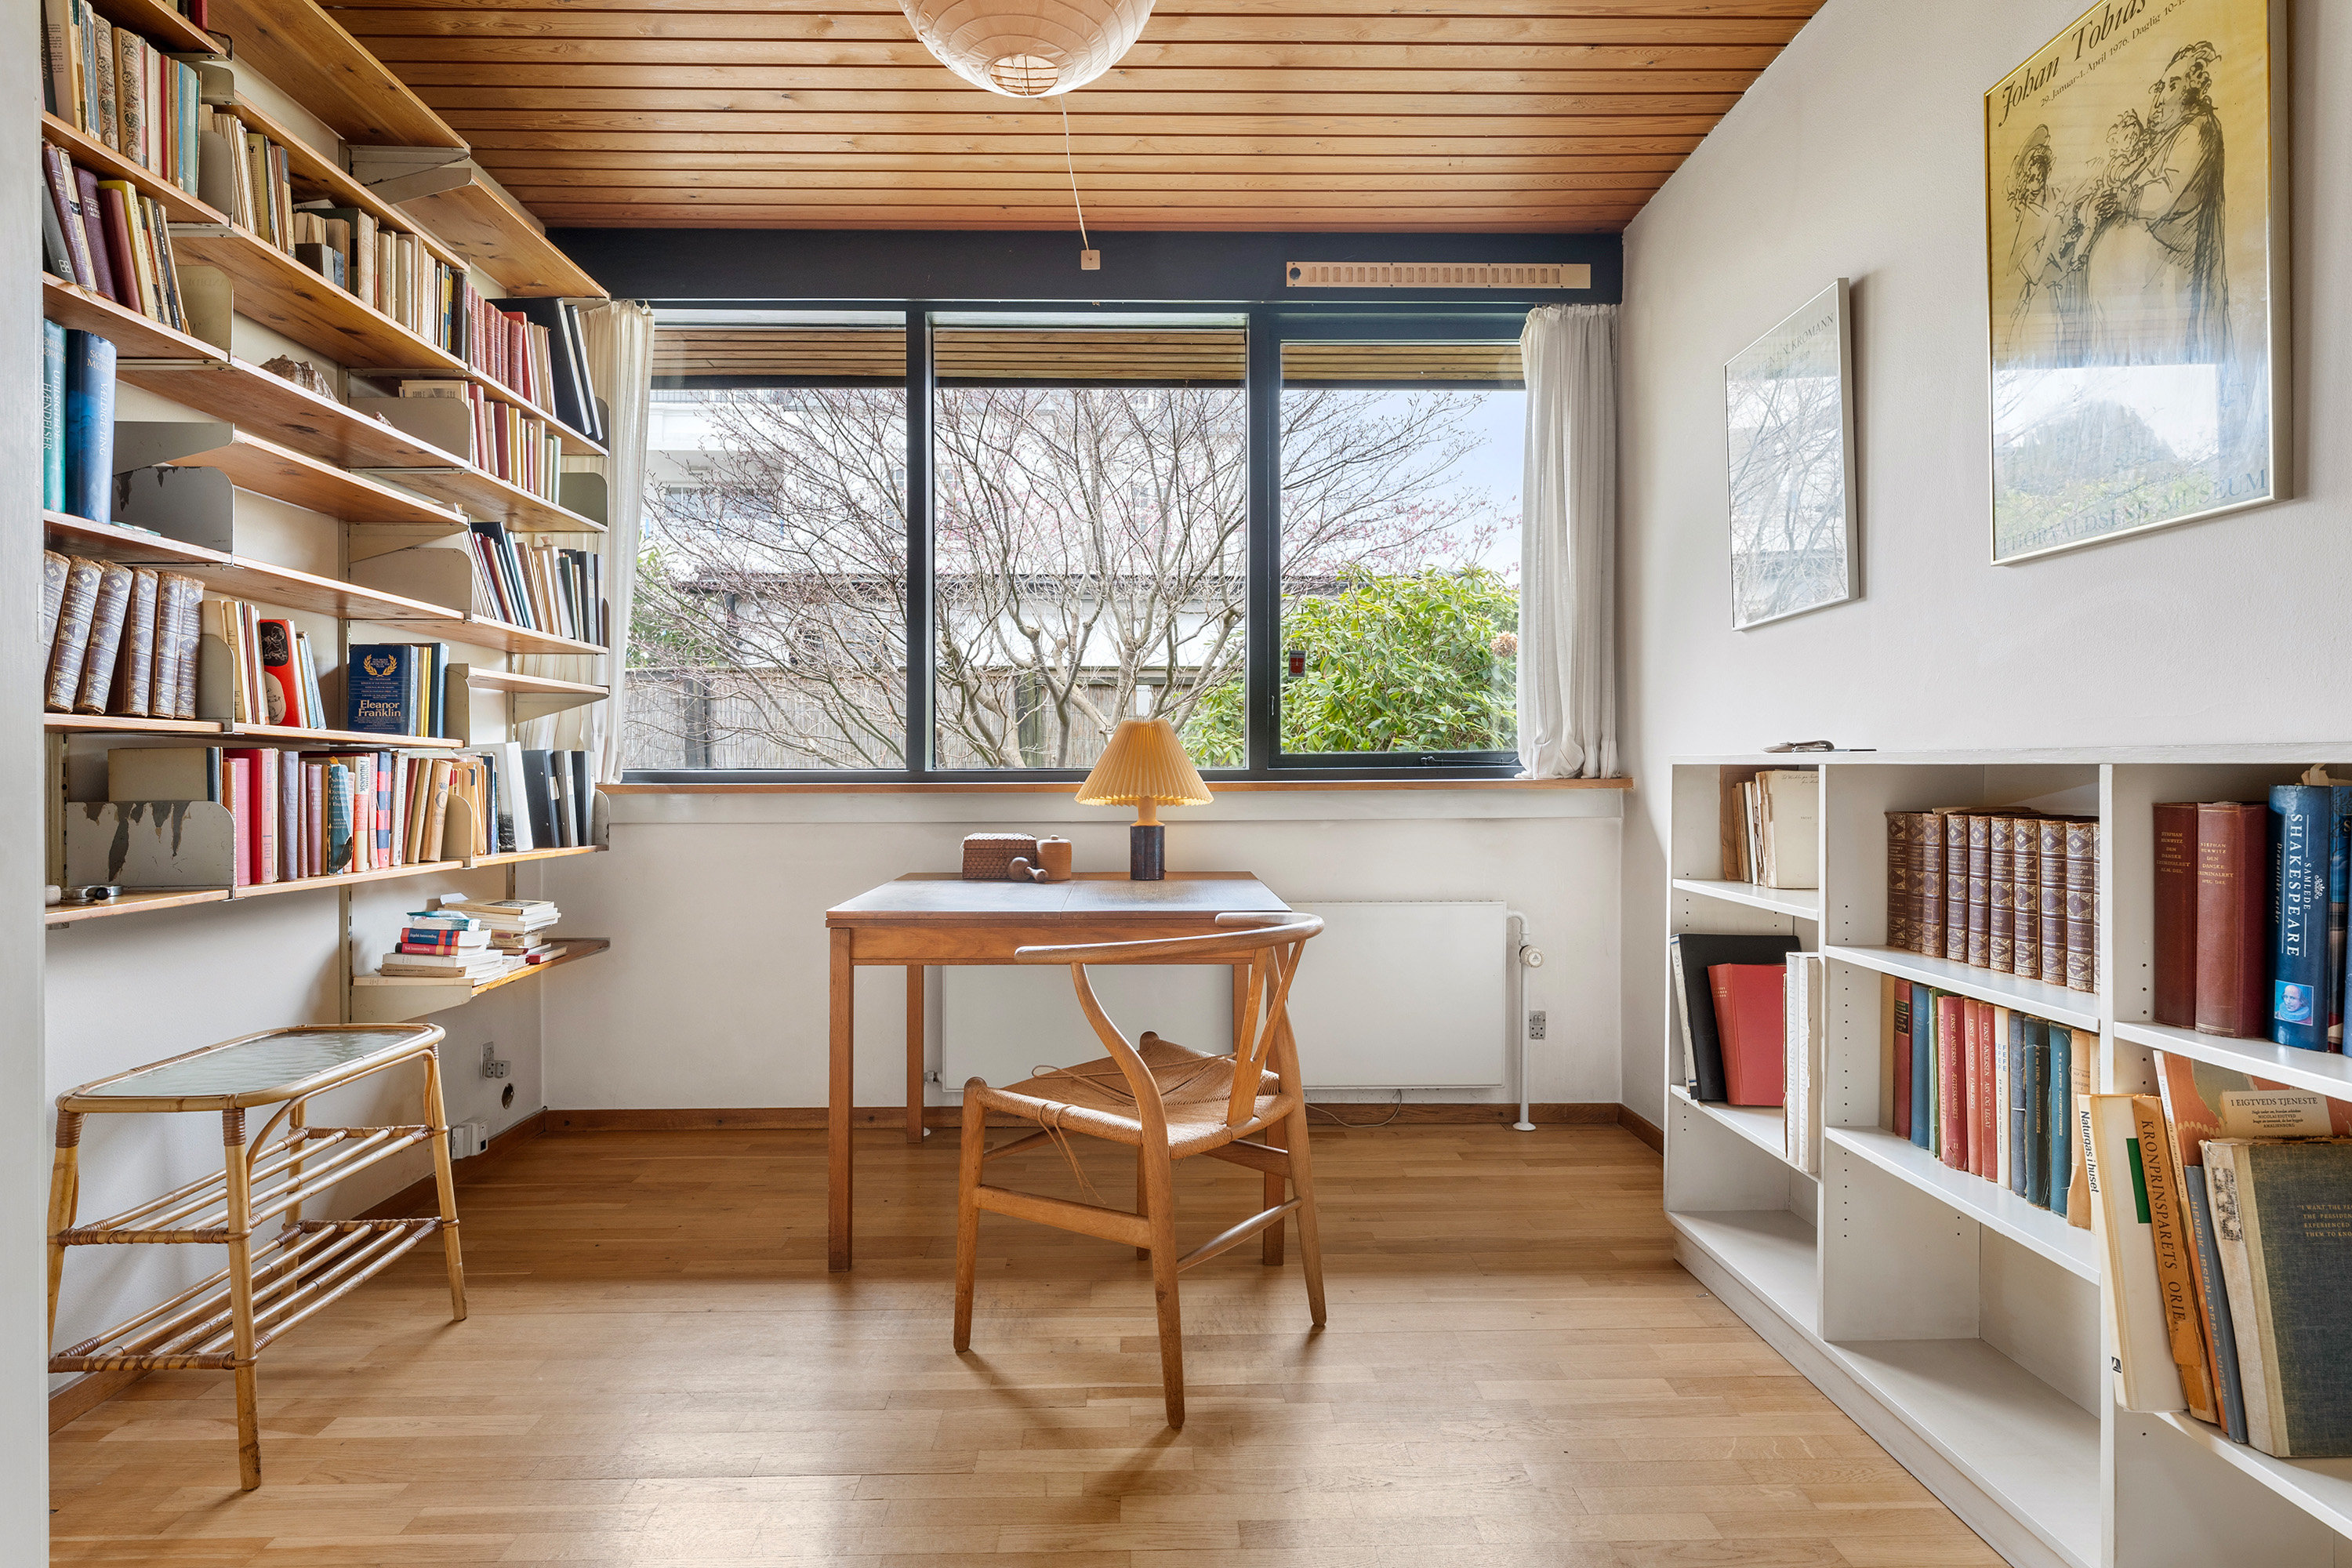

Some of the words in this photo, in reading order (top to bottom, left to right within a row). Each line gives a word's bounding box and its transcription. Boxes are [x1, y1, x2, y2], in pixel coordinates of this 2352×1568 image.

[1998, 56, 2060, 127] Johan
[2071, 0, 2147, 63] Tobias
[2086, 52, 2107, 74] April
[2132, 13, 2161, 40] Daglig
[2164, 0, 2187, 16] 10-1
[43, 337, 64, 353] ØREN
[43, 347, 66, 364] ØRCH
[1791, 313, 1835, 350] KROMANN
[43, 383, 53, 450] HÆNDELSER
[1999, 499, 2151, 552] THORVALDSENS
[2159, 469, 2267, 513] MUSEUM
[361, 700, 400, 709] Eleanor
[2287, 814, 2303, 956] SHAKESPEARE
[1984, 1096, 1991, 1106] OG
[2236, 1098, 2277, 1106] EIGTVEDS
[2278, 1097, 2318, 1106] TJENESTE
[2080, 1110, 2093, 1157] Naturgas
[2088, 1164, 2100, 1193] huset
[2141, 1120, 2178, 1270] KRONPRINSPARETS
[2168, 1281, 2186, 1324] ORIE
[2191, 1201, 2204, 1248] HENRIK
[2200, 1254, 2212, 1294] IBSEN
